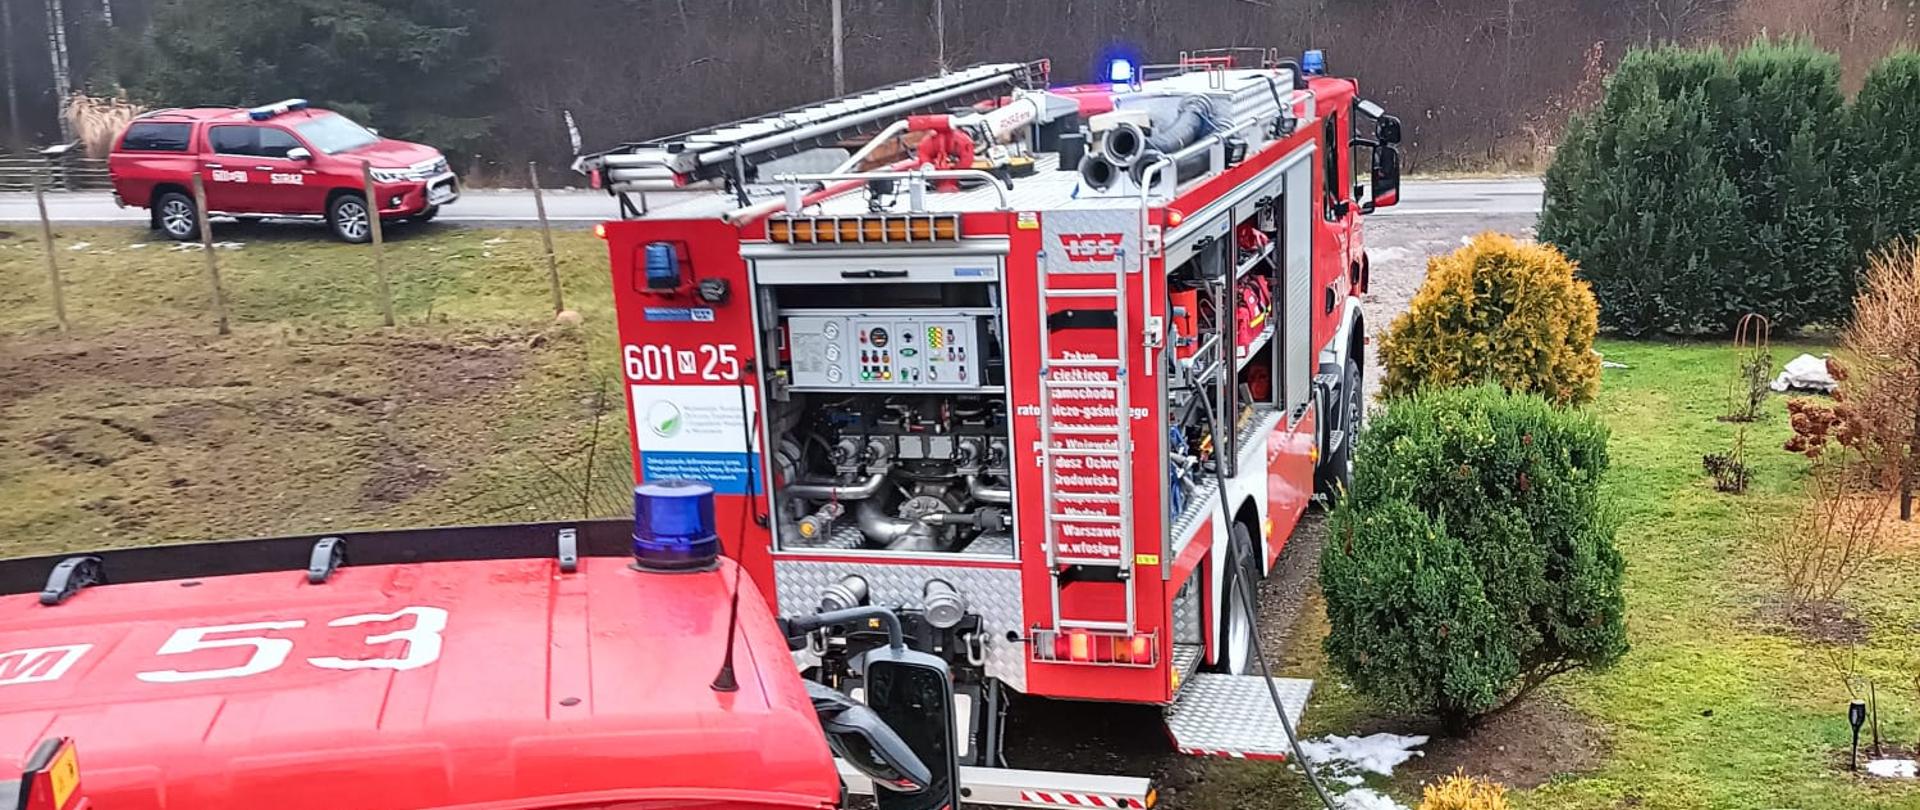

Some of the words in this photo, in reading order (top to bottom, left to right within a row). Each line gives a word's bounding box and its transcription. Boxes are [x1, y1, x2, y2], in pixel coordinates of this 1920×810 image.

[624, 344, 676, 380] 601
[678, 352, 695, 372] M
[700, 344, 739, 380] 25
[136, 606, 448, 683] 53
